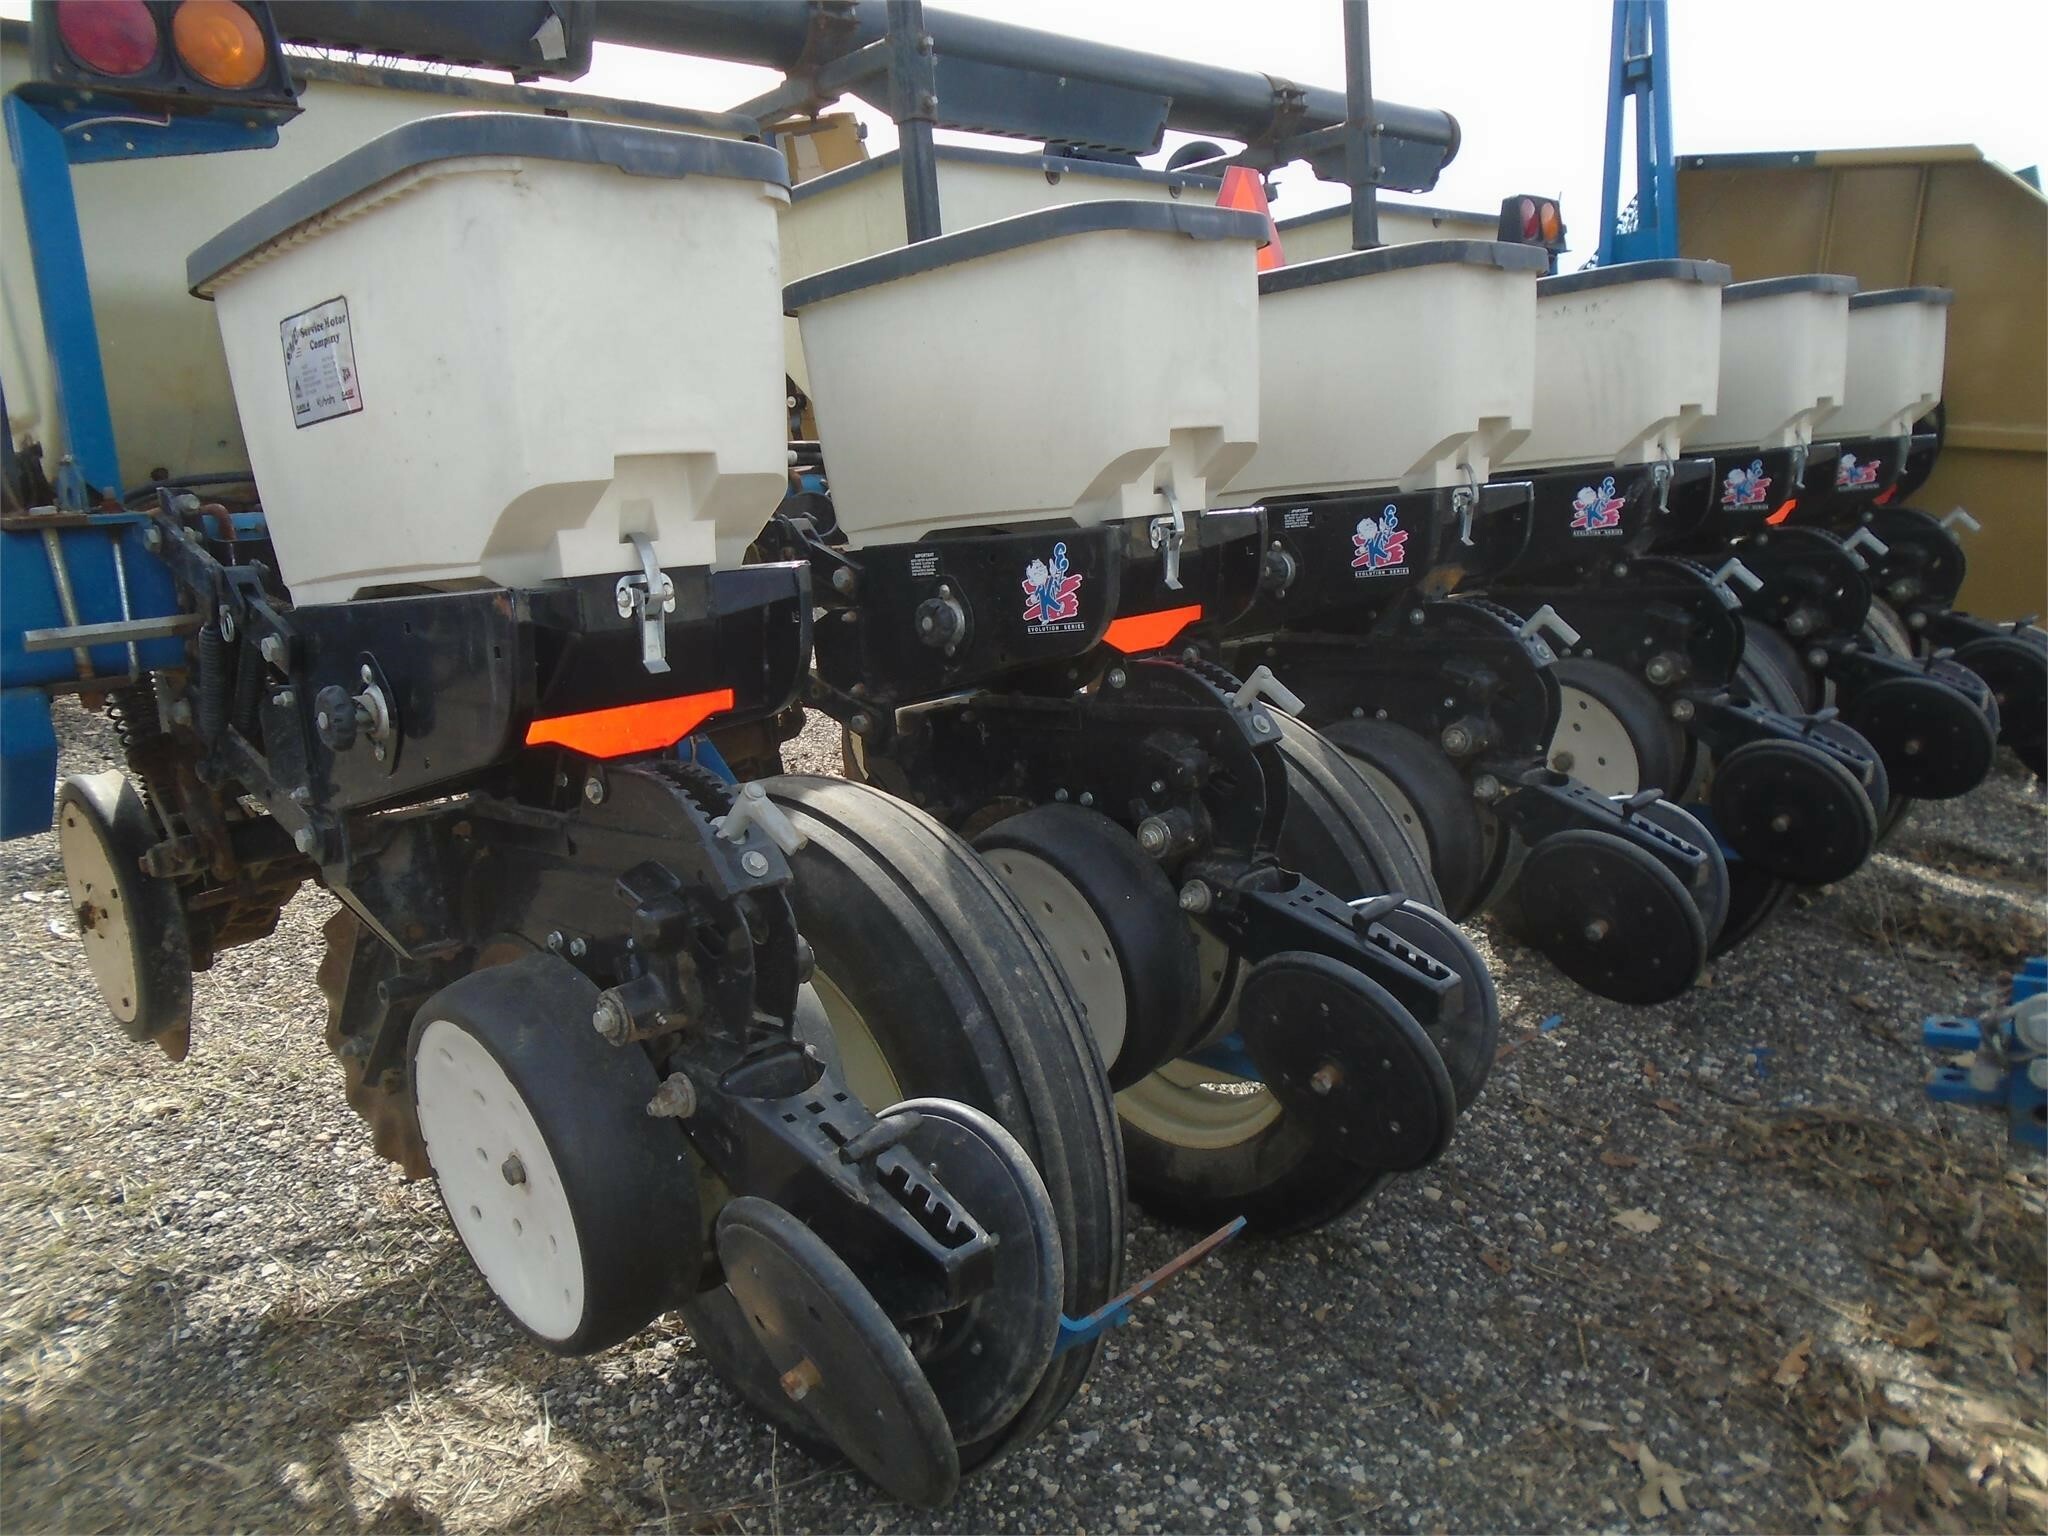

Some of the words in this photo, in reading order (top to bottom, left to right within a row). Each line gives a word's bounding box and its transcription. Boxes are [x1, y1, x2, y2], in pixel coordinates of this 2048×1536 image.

[300, 323, 324, 338] Service
[324, 315, 346, 328] Motor
[309, 334, 340, 350] Company
[1027, 625, 1059, 633] EVOLUTION
